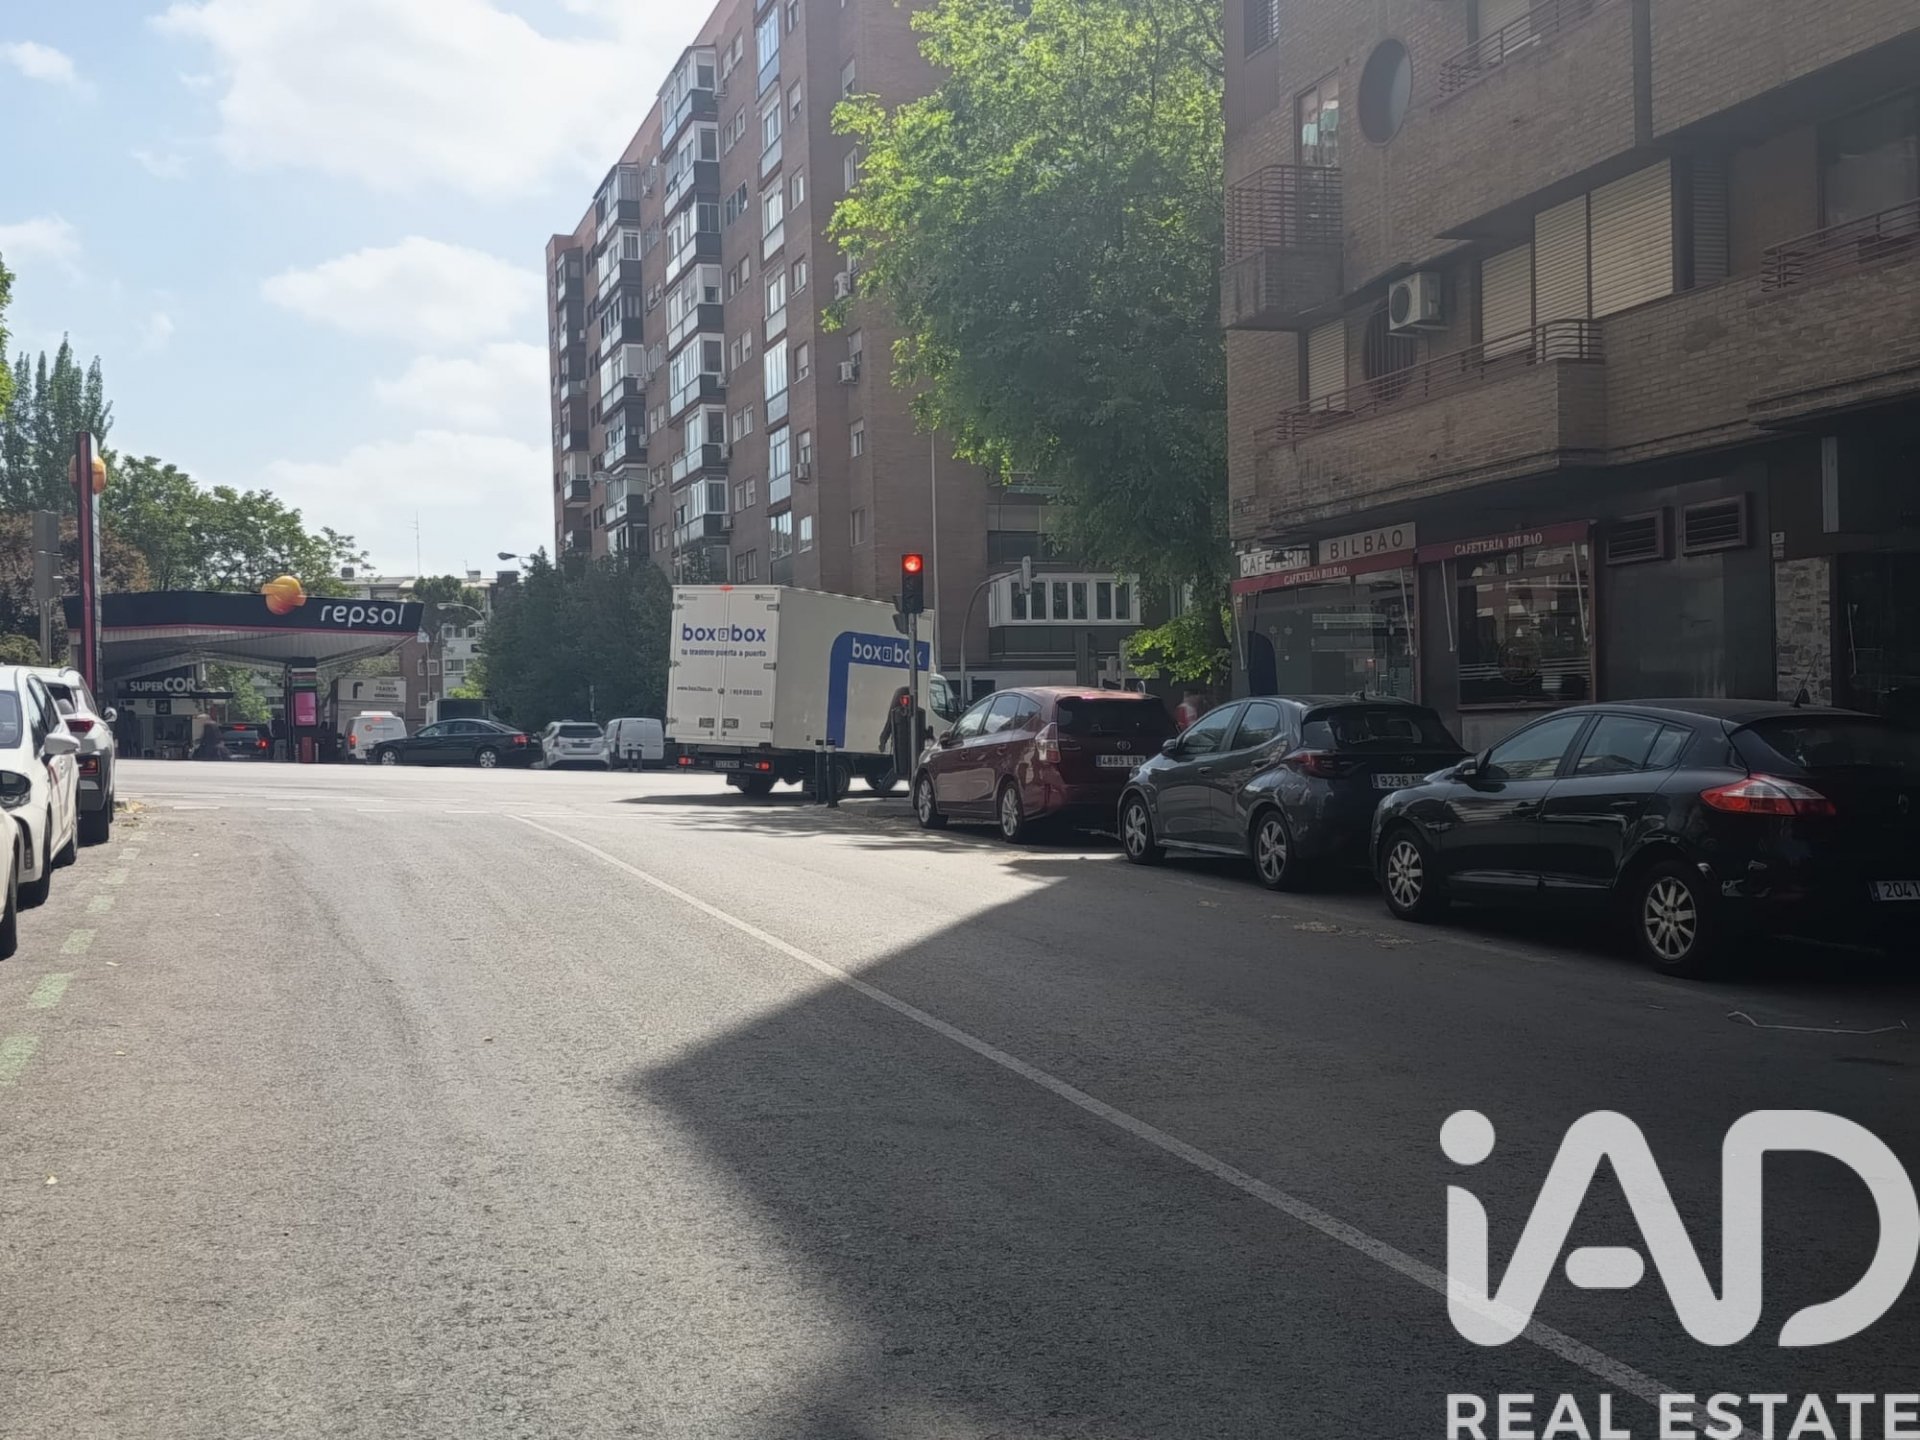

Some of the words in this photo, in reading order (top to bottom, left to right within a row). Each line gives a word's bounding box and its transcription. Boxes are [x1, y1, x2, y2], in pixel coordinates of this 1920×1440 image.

[1330, 529, 1403, 560] BILBAO
[1507, 532, 1543, 549] BILBAO
[320, 604, 404, 627] repsol
[130, 678, 196, 692] SUPERCOR
[1380, 775, 1408, 787] 9236
